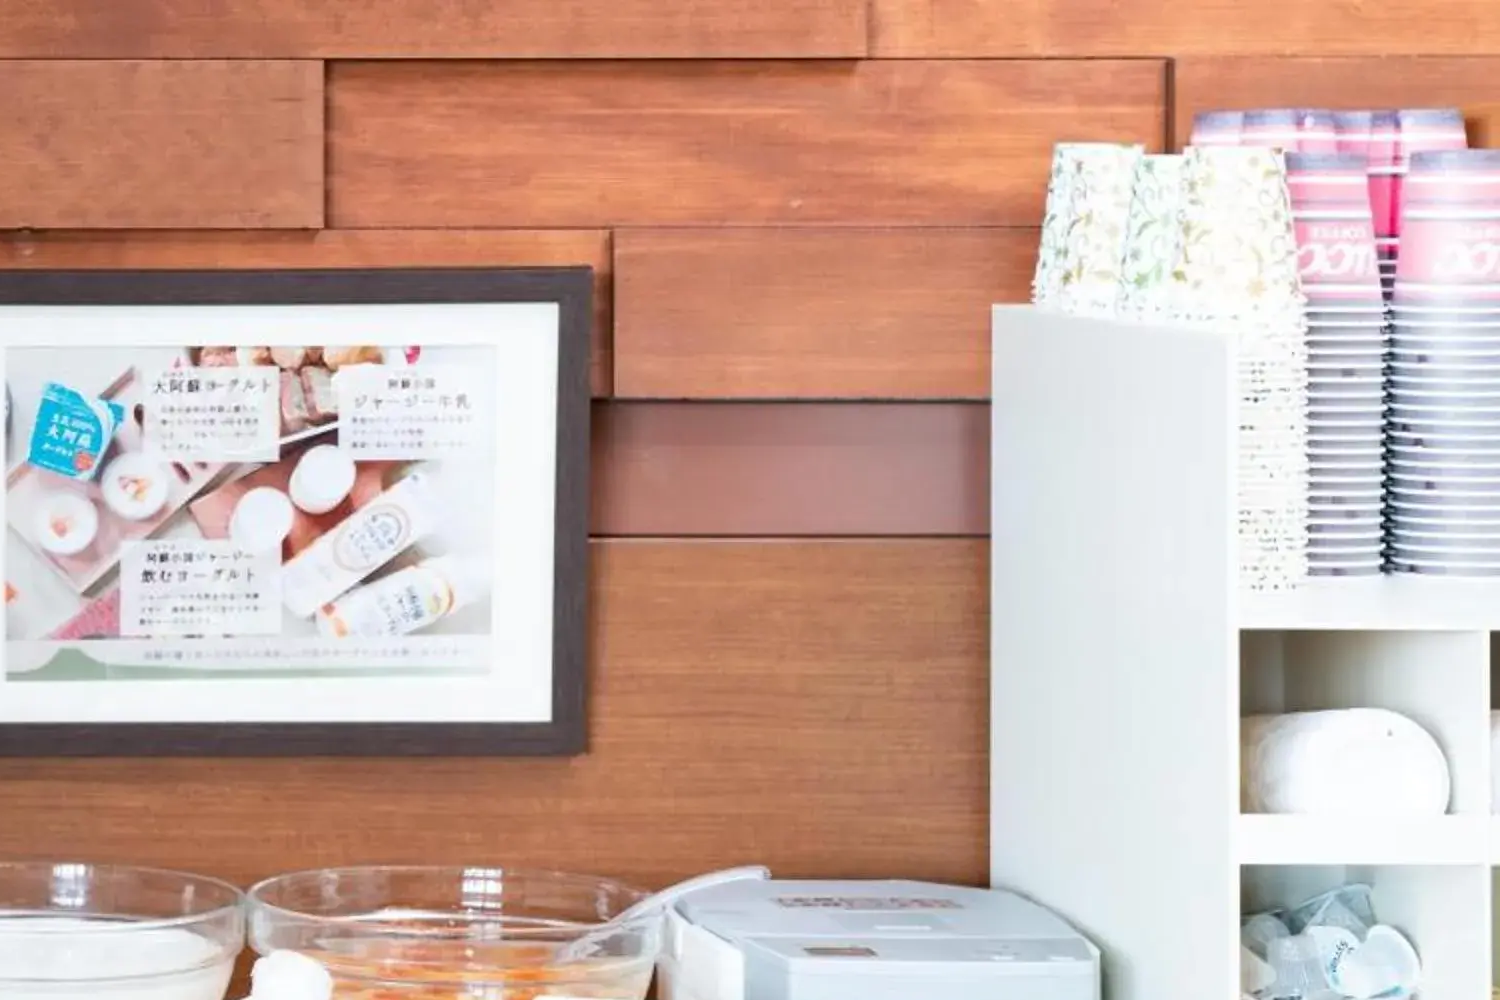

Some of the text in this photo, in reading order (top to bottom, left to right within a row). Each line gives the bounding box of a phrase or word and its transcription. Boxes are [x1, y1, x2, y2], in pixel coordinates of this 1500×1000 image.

[153, 378, 271, 394] 大阿蘇ヨーグルト
[354, 393, 472, 411] ジャージー牛乳
[140, 568, 256, 584] 飲むヨーグルト
